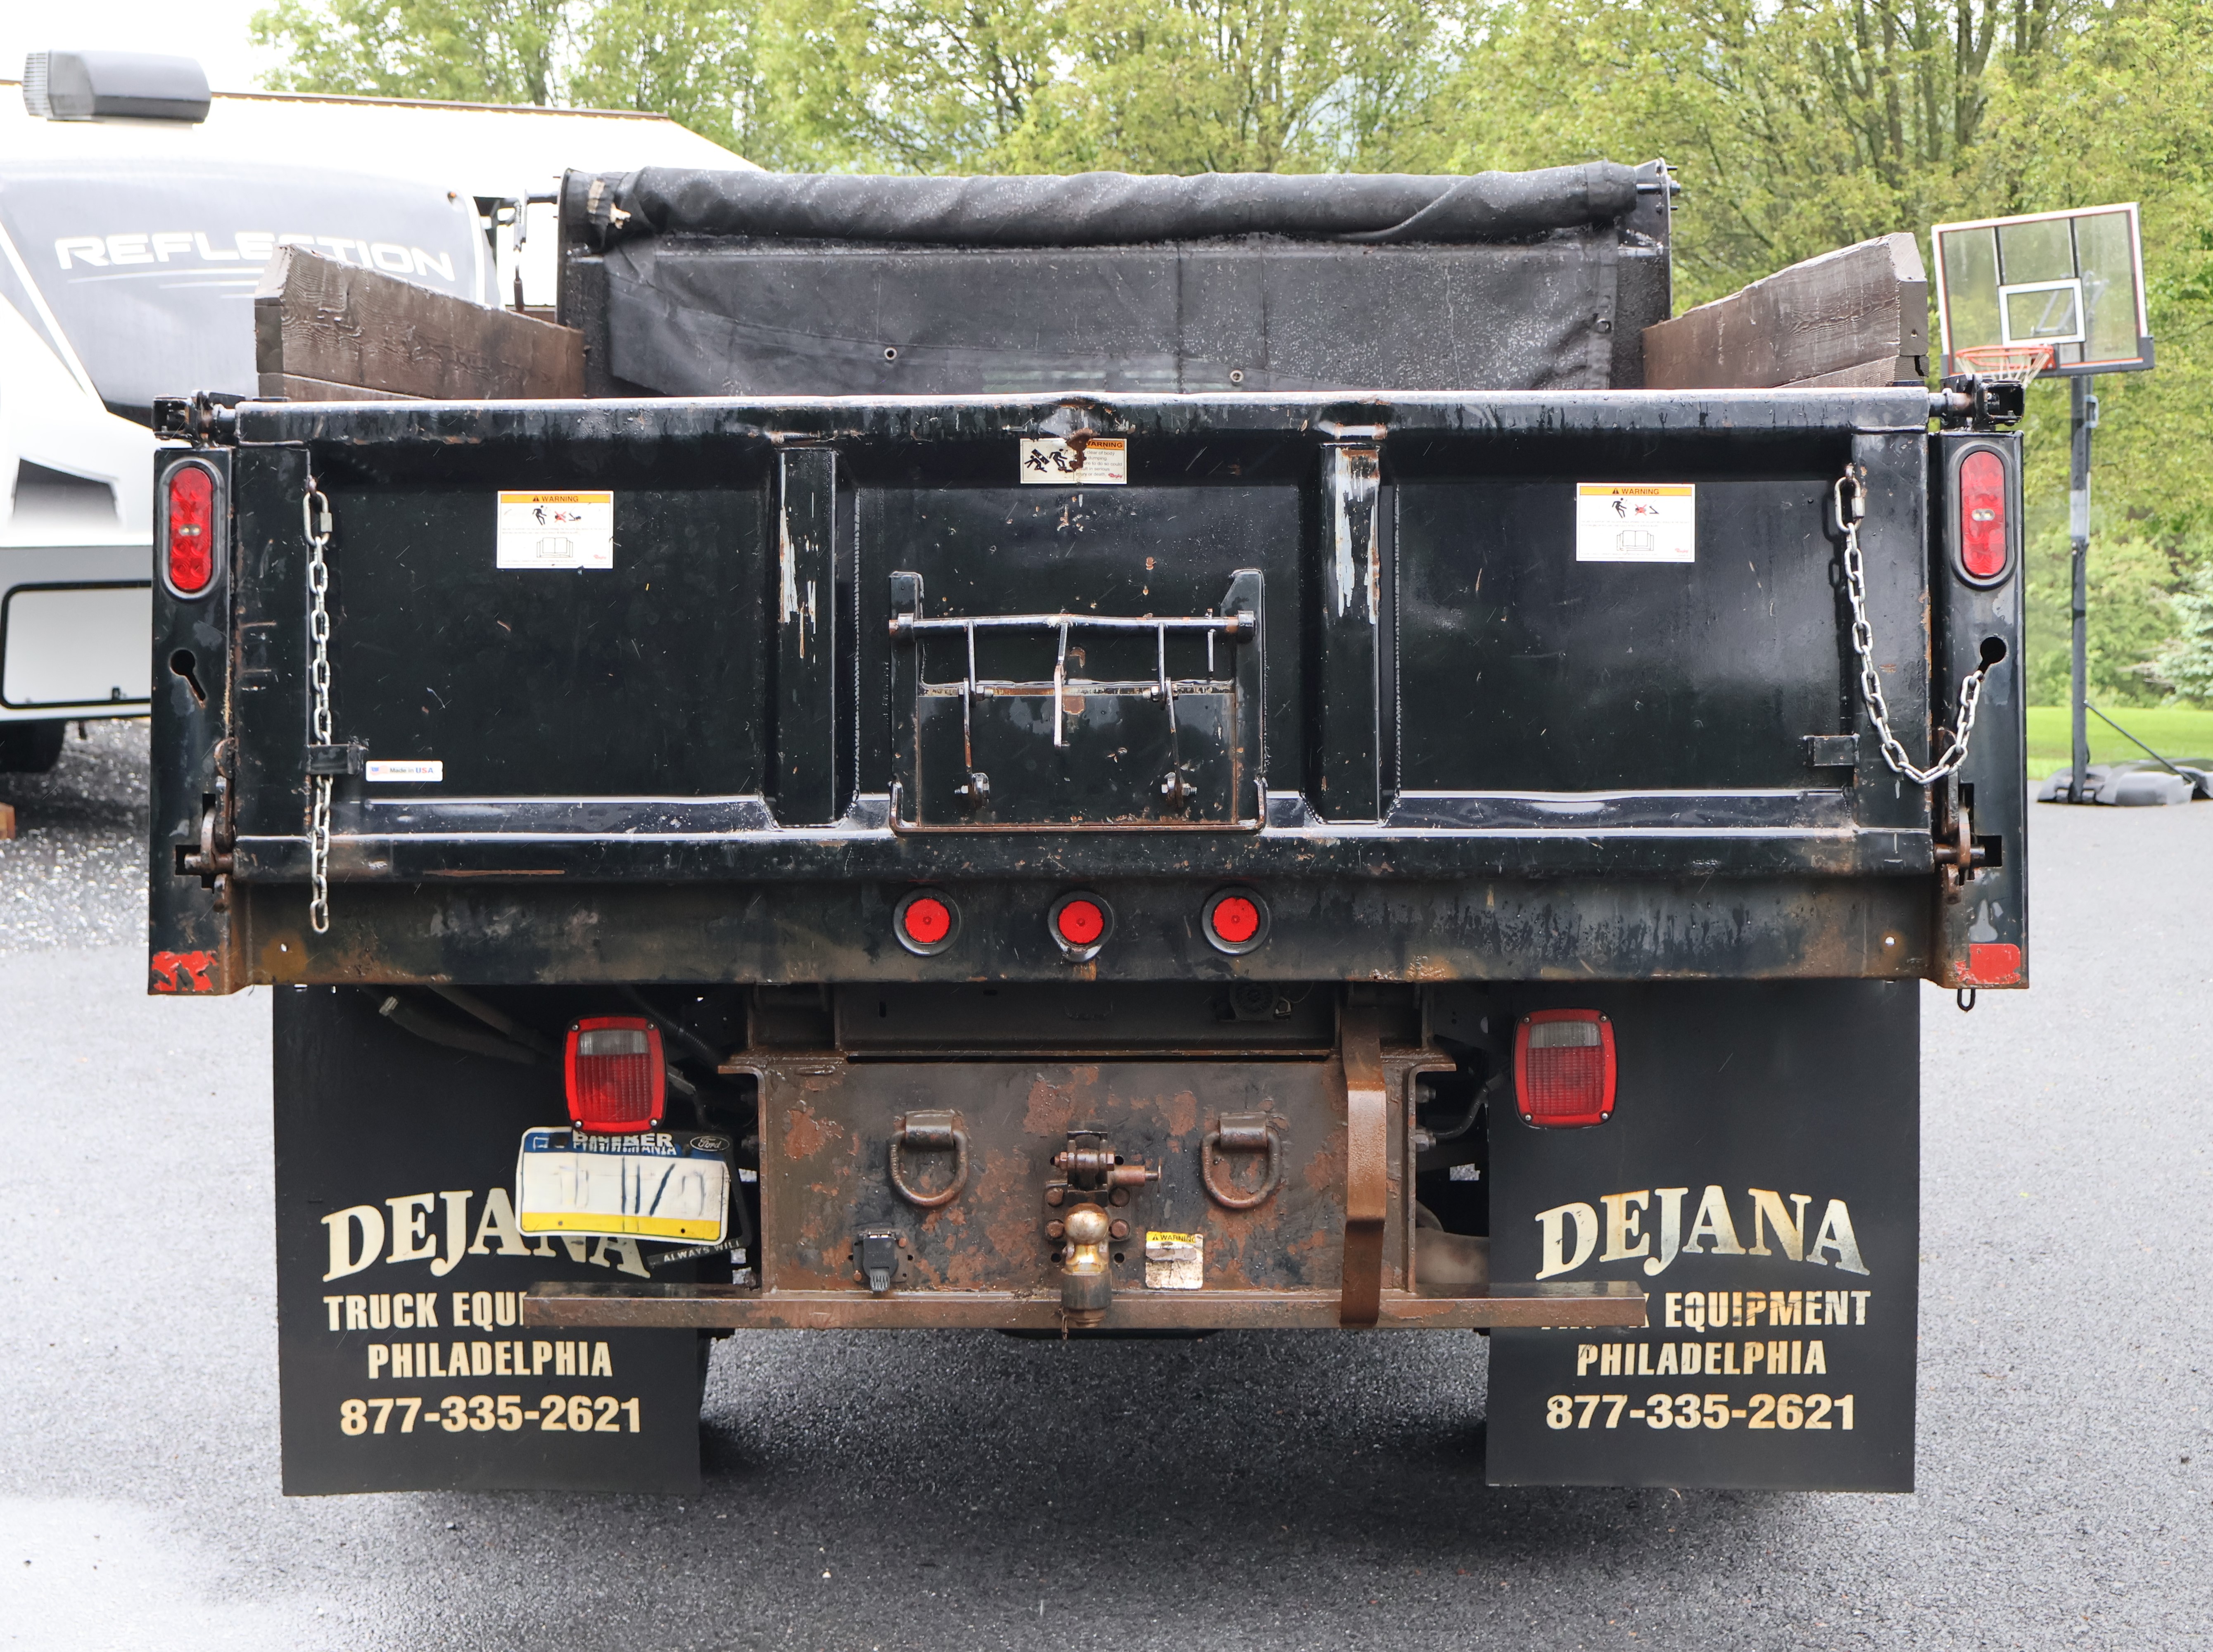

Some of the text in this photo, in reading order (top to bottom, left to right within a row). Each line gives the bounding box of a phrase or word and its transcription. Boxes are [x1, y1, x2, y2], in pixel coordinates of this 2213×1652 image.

[55, 231, 455, 282] REFLETION
[698, 1138, 722, 1148] Ford
[1534, 1184, 1871, 1280] DEJANA
[664, 1246, 710, 1262] ALWAYS
[323, 1292, 439, 1331] TRUCK
[1665, 1291, 1871, 1333] EQUIPMENT
[368, 1341, 613, 1379] PHILADELPHIA
[1577, 1341, 1826, 1376] PHILADELPHIA
[340, 1395, 641, 1436] 877-335-2621
[1546, 1394, 1854, 1430] 877-335-2621
